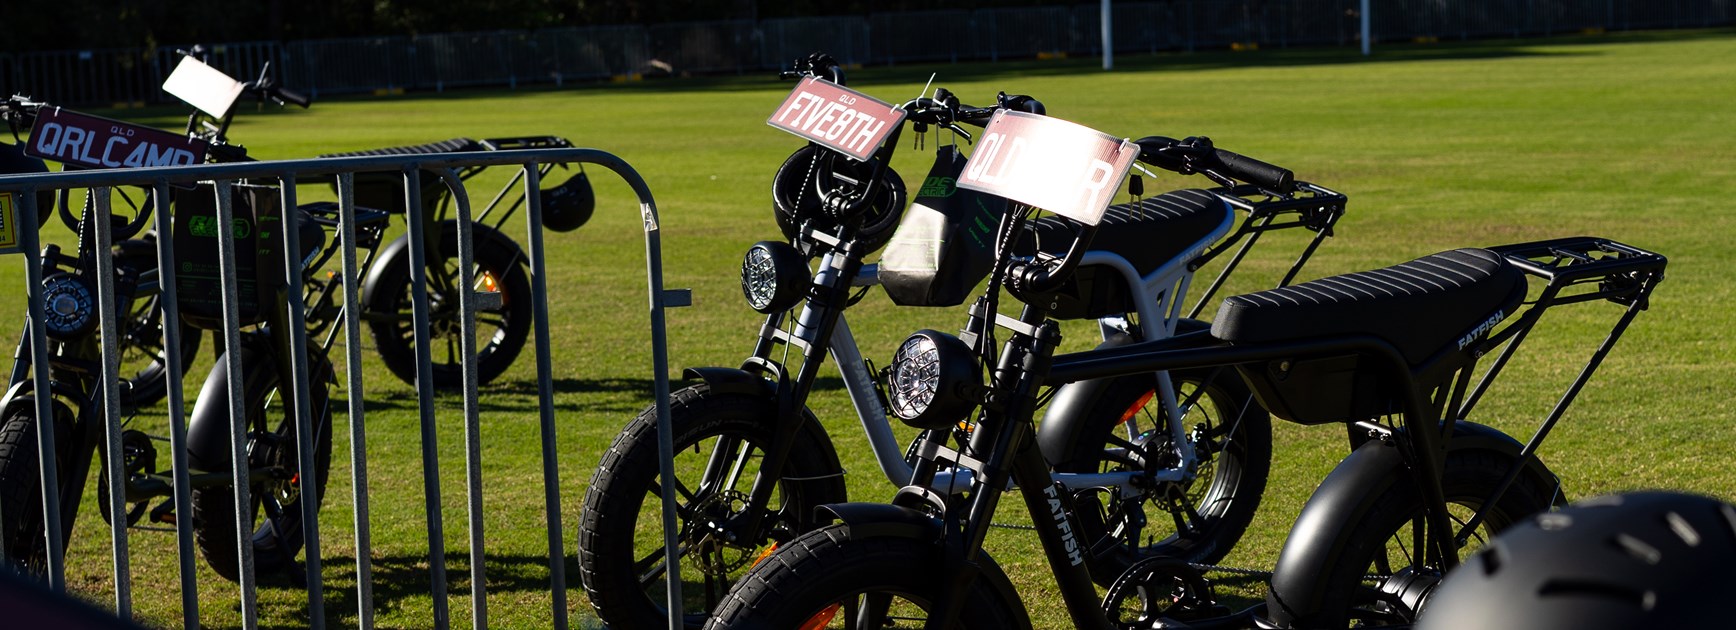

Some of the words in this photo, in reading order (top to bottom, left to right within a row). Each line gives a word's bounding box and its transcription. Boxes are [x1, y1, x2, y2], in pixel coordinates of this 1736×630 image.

[777, 91, 886, 153] FIVE8TH
[838, 94, 857, 106] QLD
[110, 125, 135, 138] QLD
[1458, 309, 1504, 351] FATFISH
[852, 360, 884, 420] FATFISH
[1043, 484, 1083, 567] FATFISH
